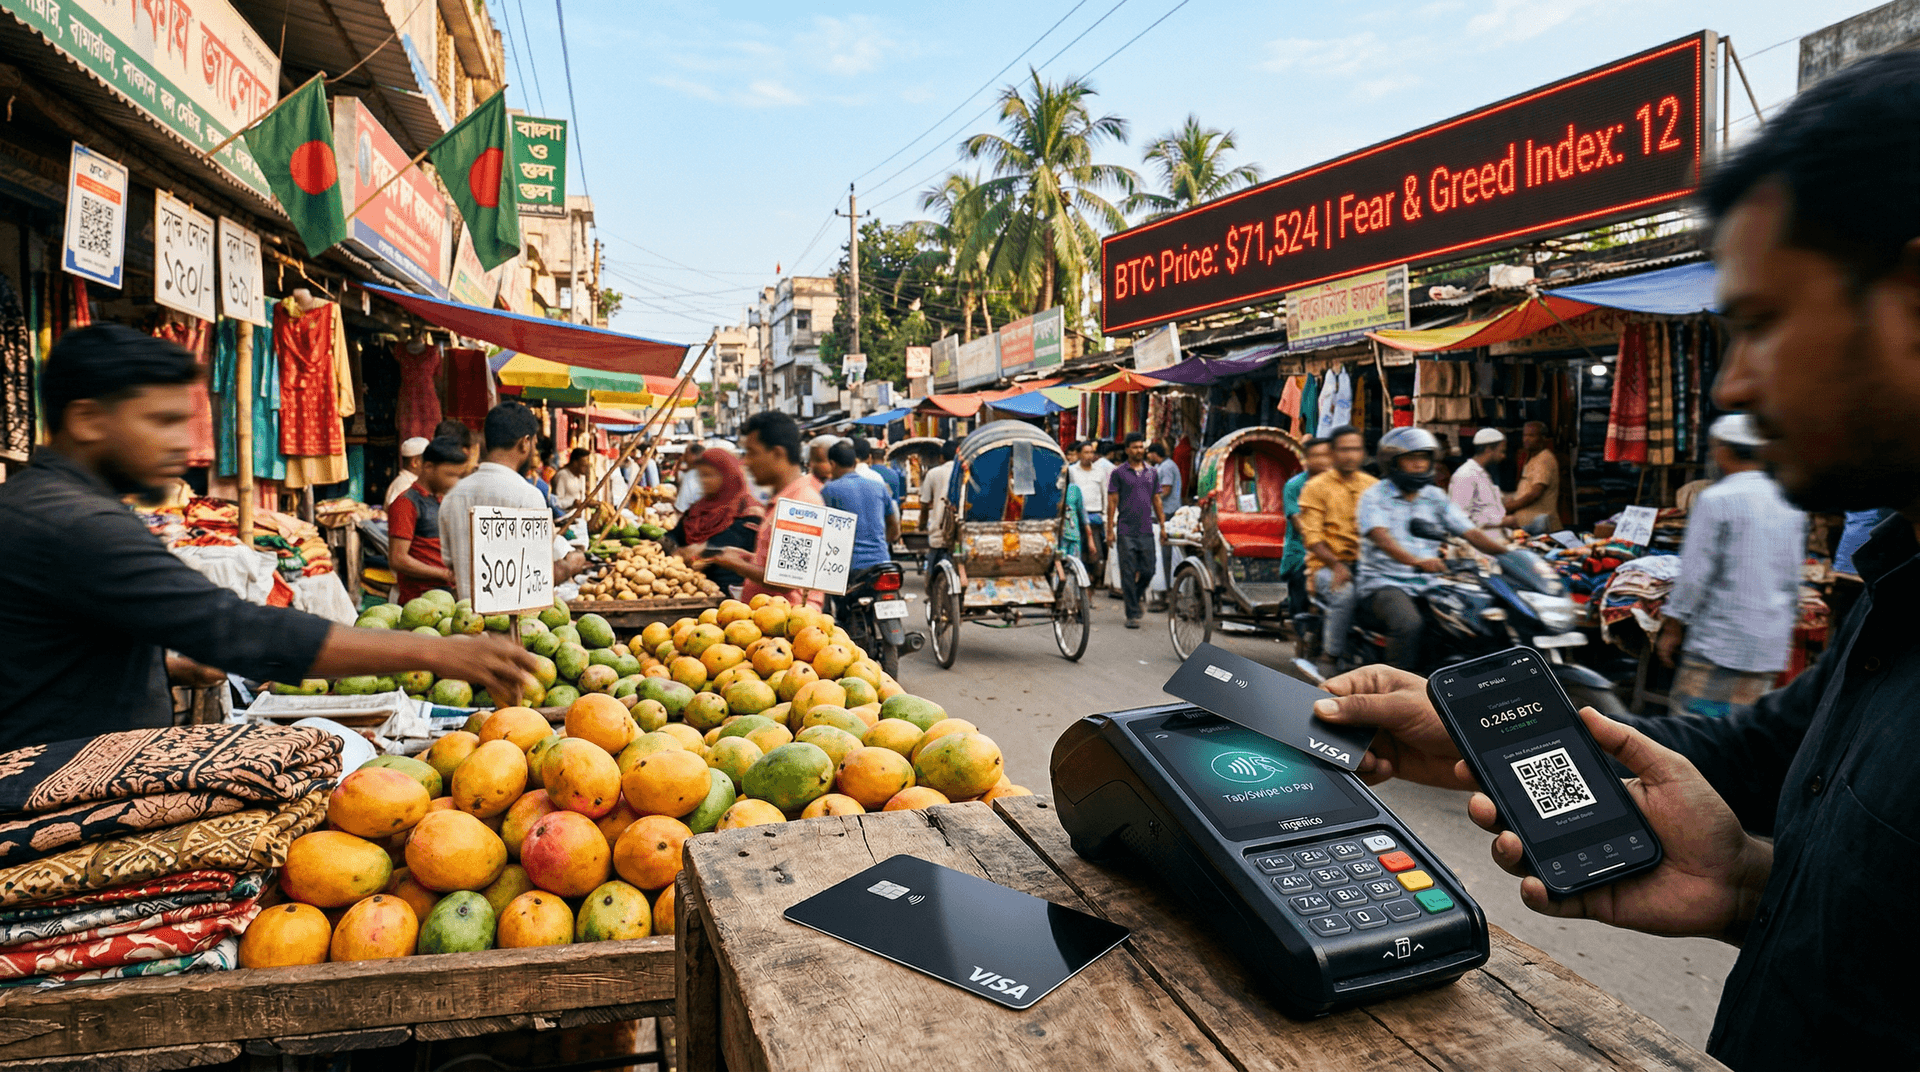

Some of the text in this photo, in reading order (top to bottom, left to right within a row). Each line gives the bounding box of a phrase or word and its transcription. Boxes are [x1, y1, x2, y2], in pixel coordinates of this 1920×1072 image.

[1115, 255, 1155, 300] BTC
[1160, 243, 1219, 288] Price:
[1226, 205, 1319, 275] $71,524
[1340, 191, 1396, 239] Fear
[1402, 174, 1422, 221] &
[1429, 142, 1516, 213] Greed
[1526, 123, 1624, 188] Index:
[1636, 95, 1681, 156] 12
[1480, 709, 1517, 728] 0.245
[1516, 702, 1543, 718] BTC
[1307, 735, 1351, 765] VISA
[1222, 781, 1315, 804] Tap/Swipe to Pay
[1278, 815, 1324, 832] ingenico
[1356, 911, 1371, 922] 0
[968, 965, 1030, 1000] VISA
